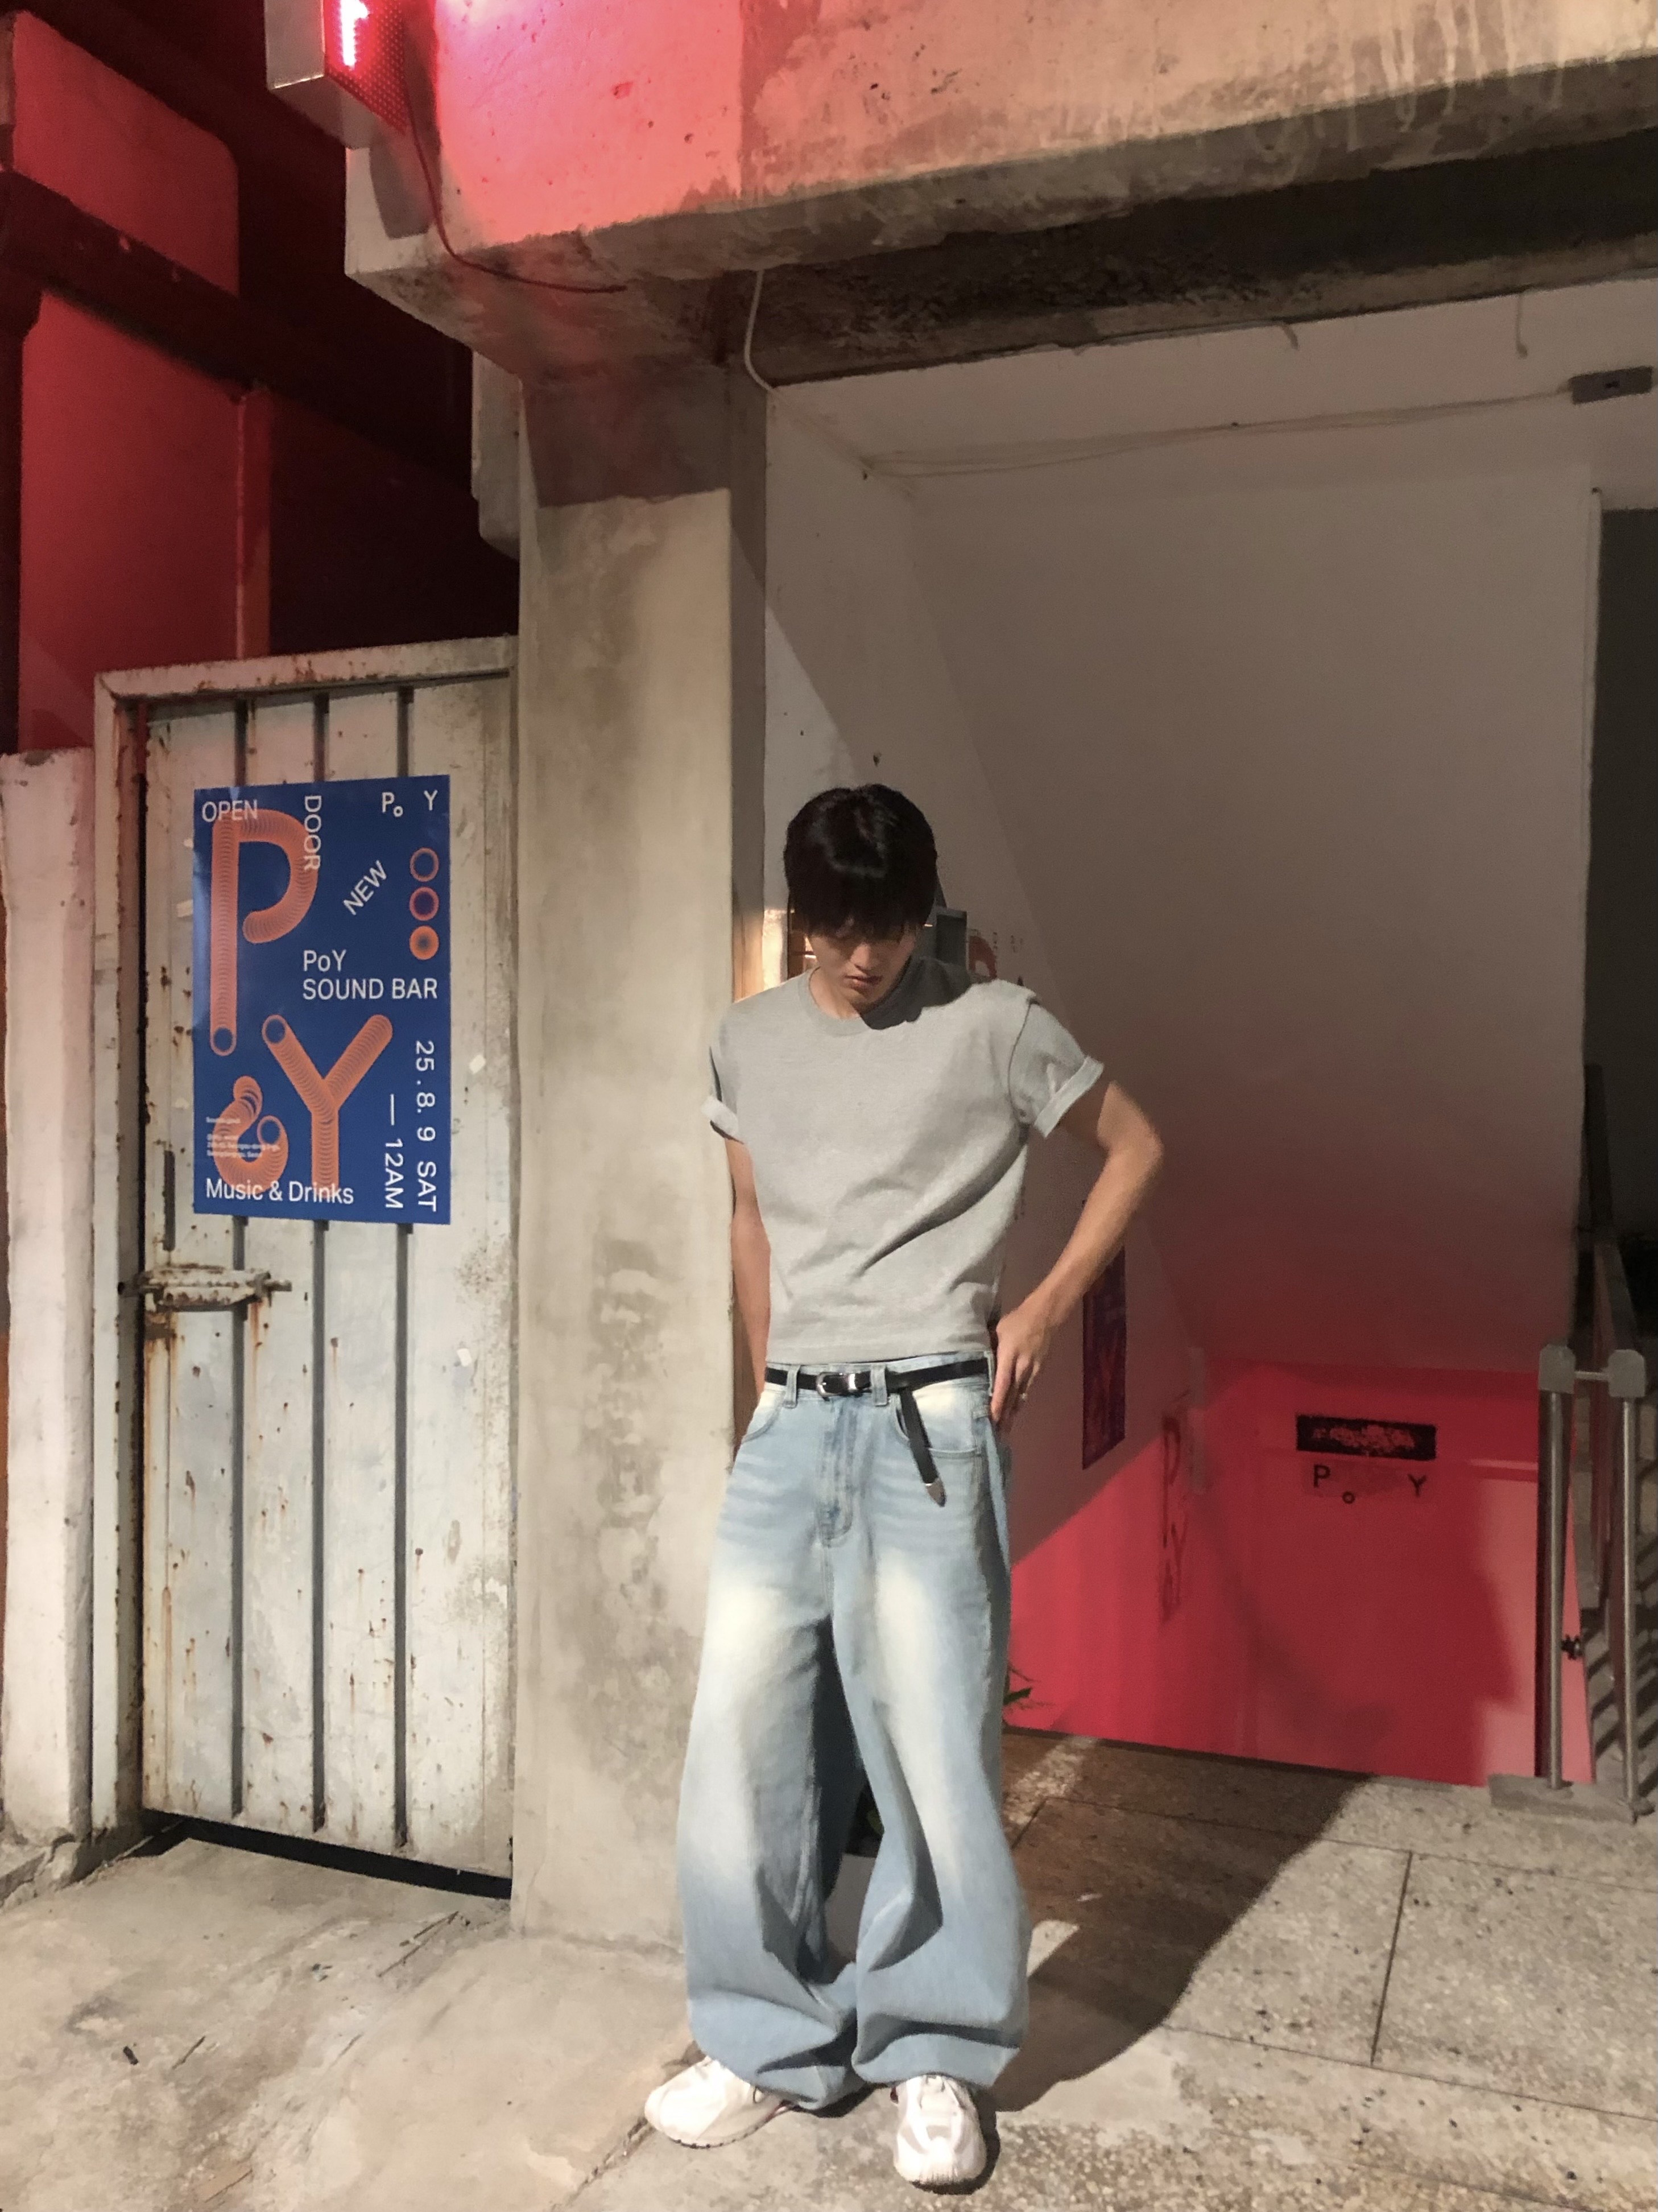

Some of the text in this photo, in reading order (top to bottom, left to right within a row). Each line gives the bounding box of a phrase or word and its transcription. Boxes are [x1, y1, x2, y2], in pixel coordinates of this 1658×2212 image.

[201, 799, 258, 823] OPEN
[304, 795, 322, 871] DOOR
[342, 860, 387, 916] NEW
[303, 949, 347, 972] PoY
[303, 977, 438, 1000] SOUND BAR
[206, 1178, 354, 1204] Music & Drinks
[384, 1139, 404, 1209] 12AM
[417, 1161, 437, 1212] SAT
